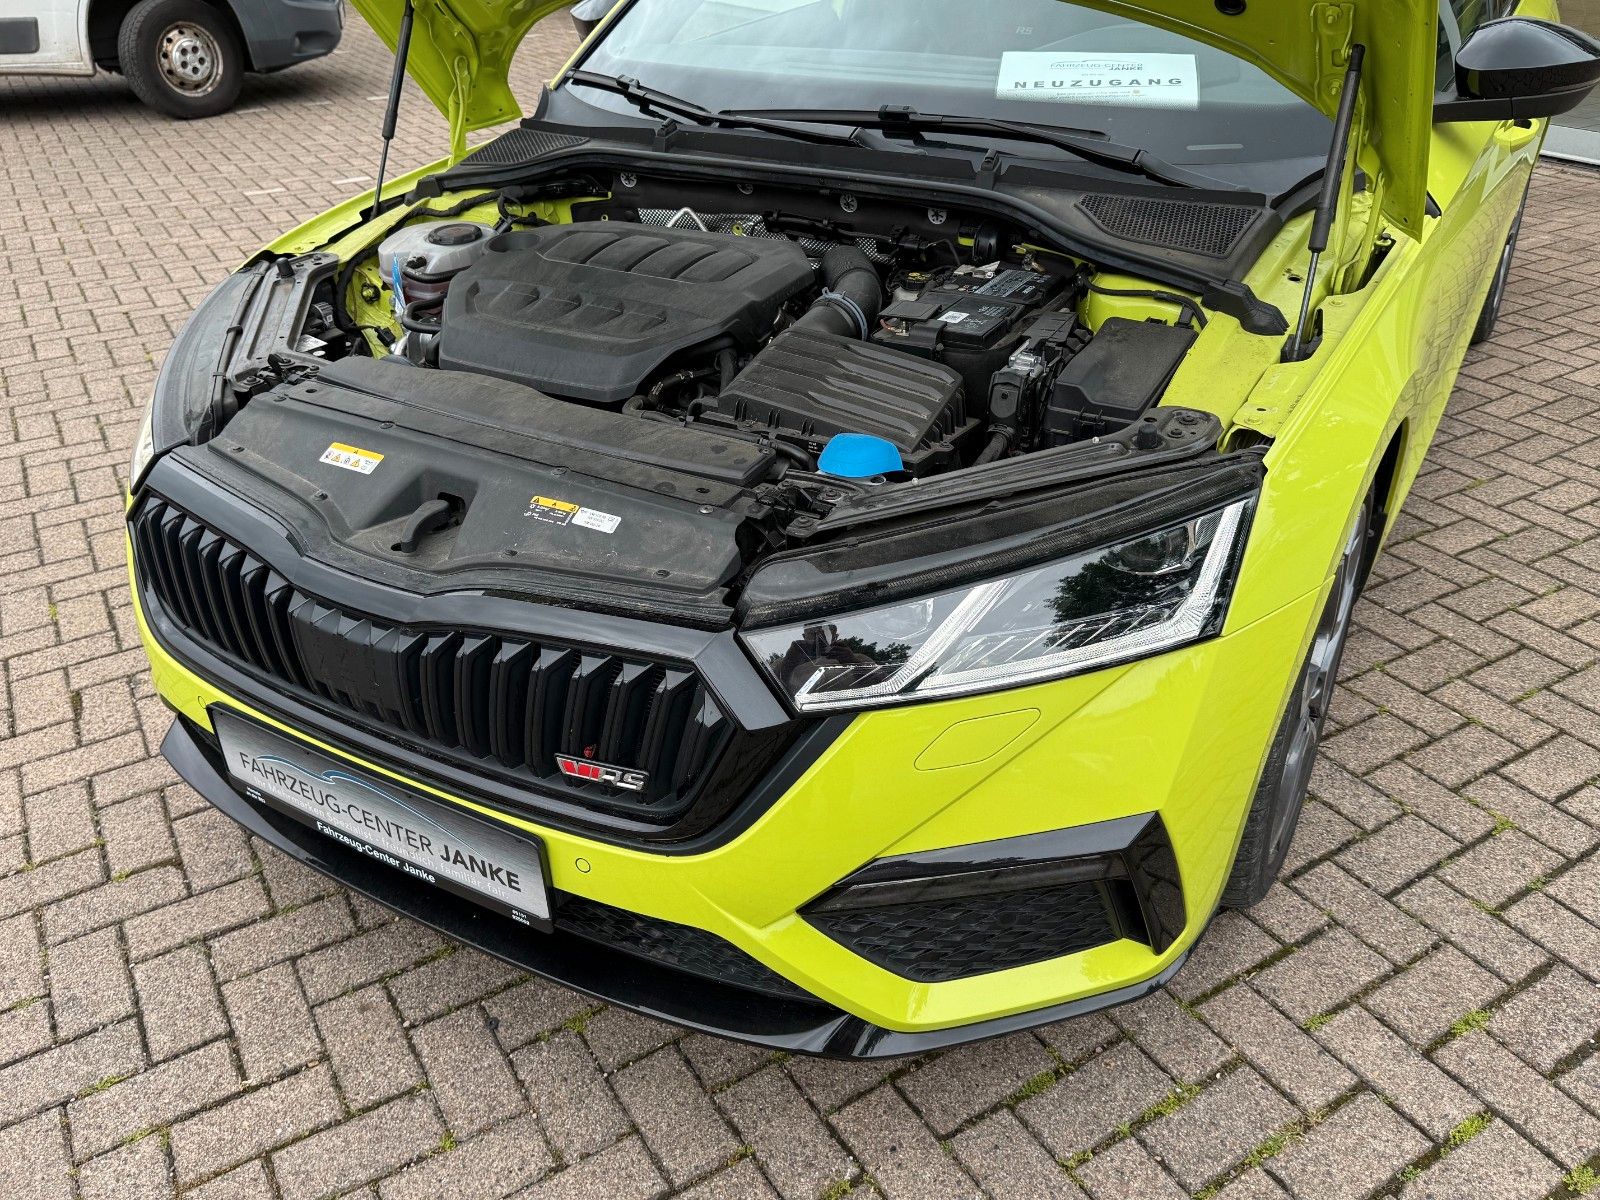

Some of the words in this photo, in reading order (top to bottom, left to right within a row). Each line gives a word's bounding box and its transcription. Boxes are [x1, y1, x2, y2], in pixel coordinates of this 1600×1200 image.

[1014, 78, 1182, 89] NEUZUGANG
[239, 752, 434, 855] FAHRZEUG-CENTER
[439, 844, 522, 893] JANKE
[316, 820, 401, 868] Fahrzeug-Center
[403, 862, 436, 884] Janke
